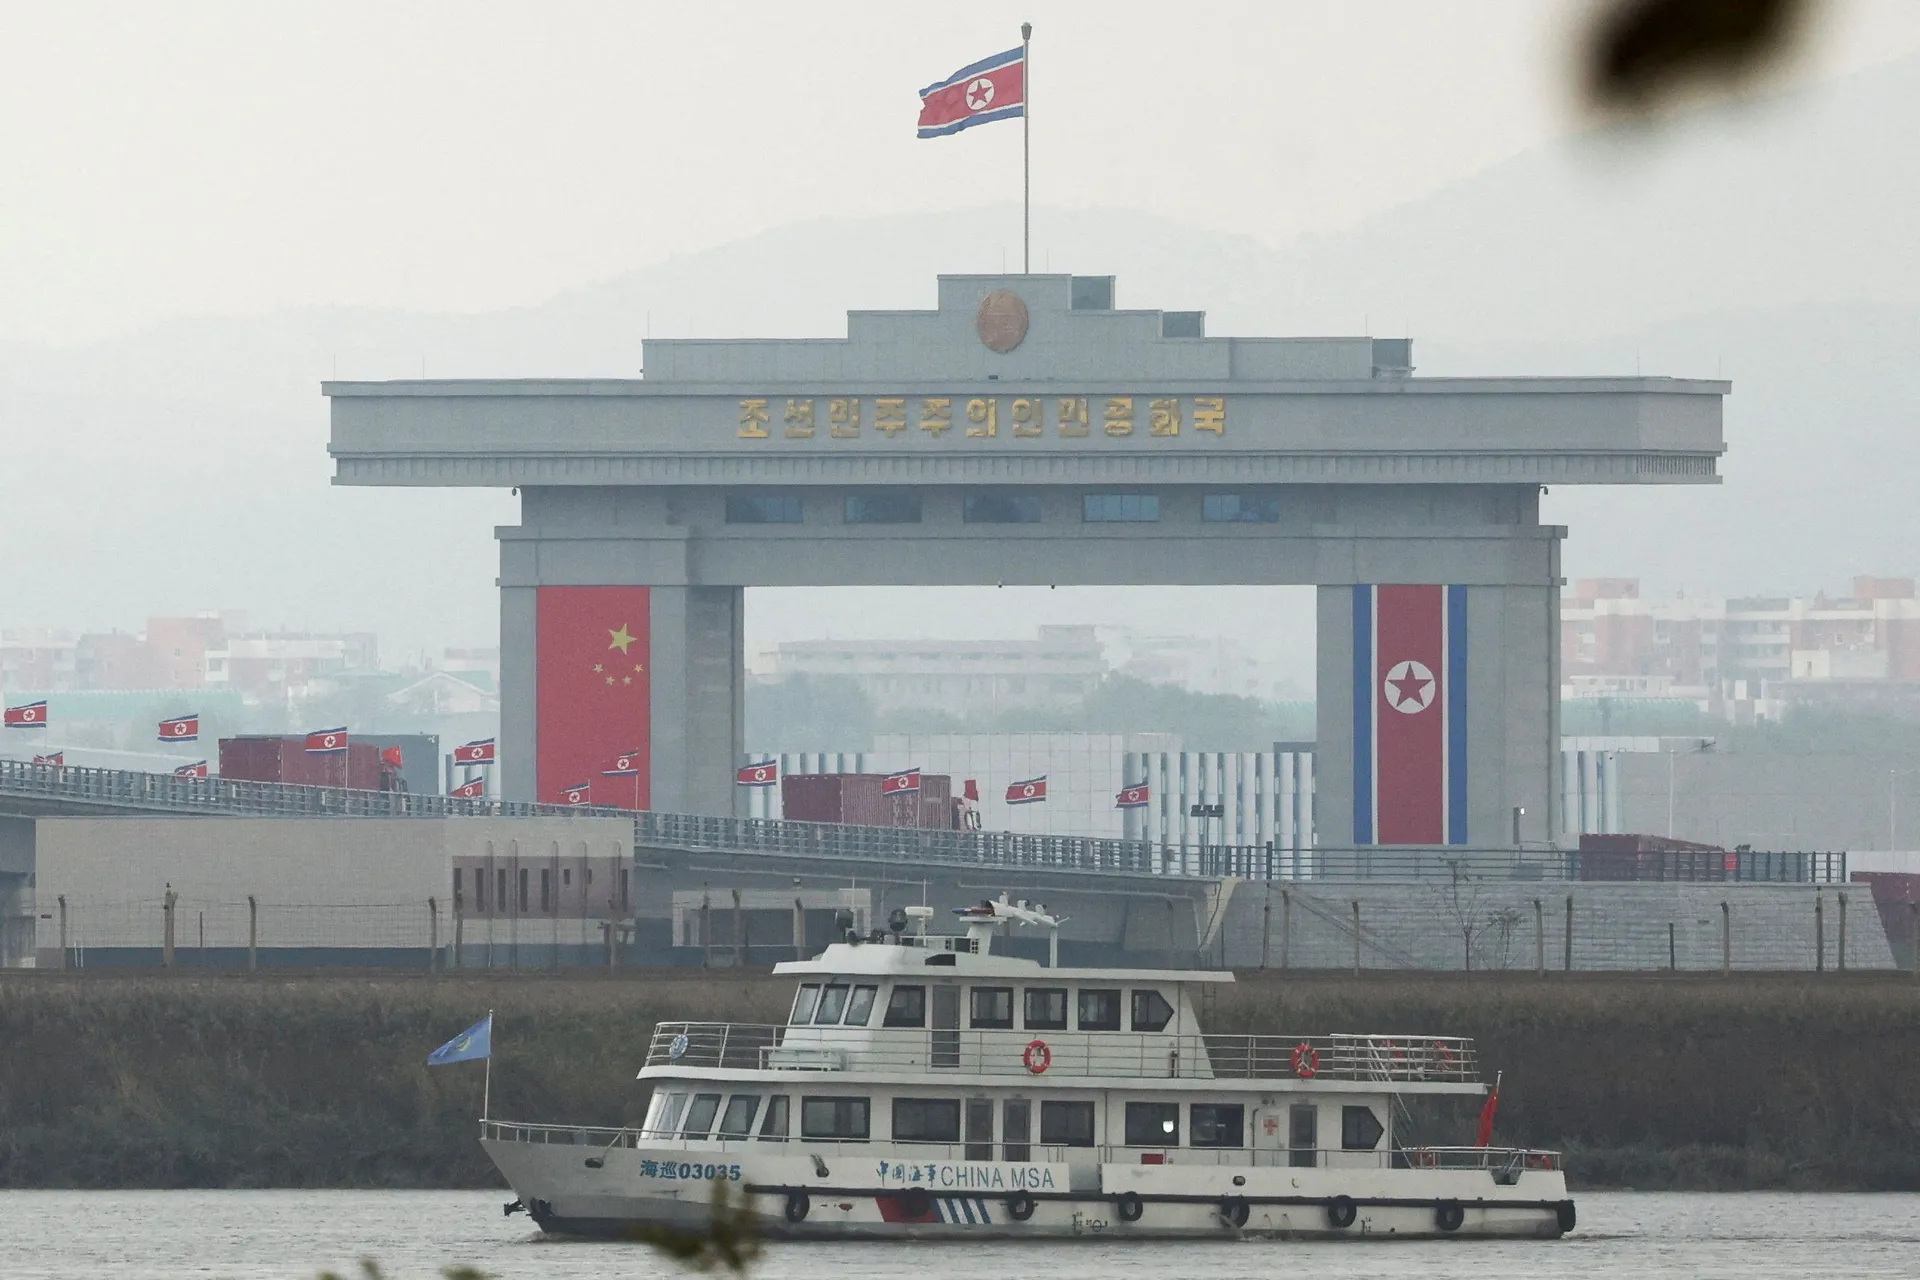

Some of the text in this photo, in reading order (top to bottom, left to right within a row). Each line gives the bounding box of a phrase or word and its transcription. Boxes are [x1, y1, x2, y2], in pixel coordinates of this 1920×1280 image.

[737, 398, 1225, 438] 조선민주주의인민공화국
[639, 1160, 741, 1181] 海巡03035
[940, 1165, 1055, 1189] CHINA MSA
